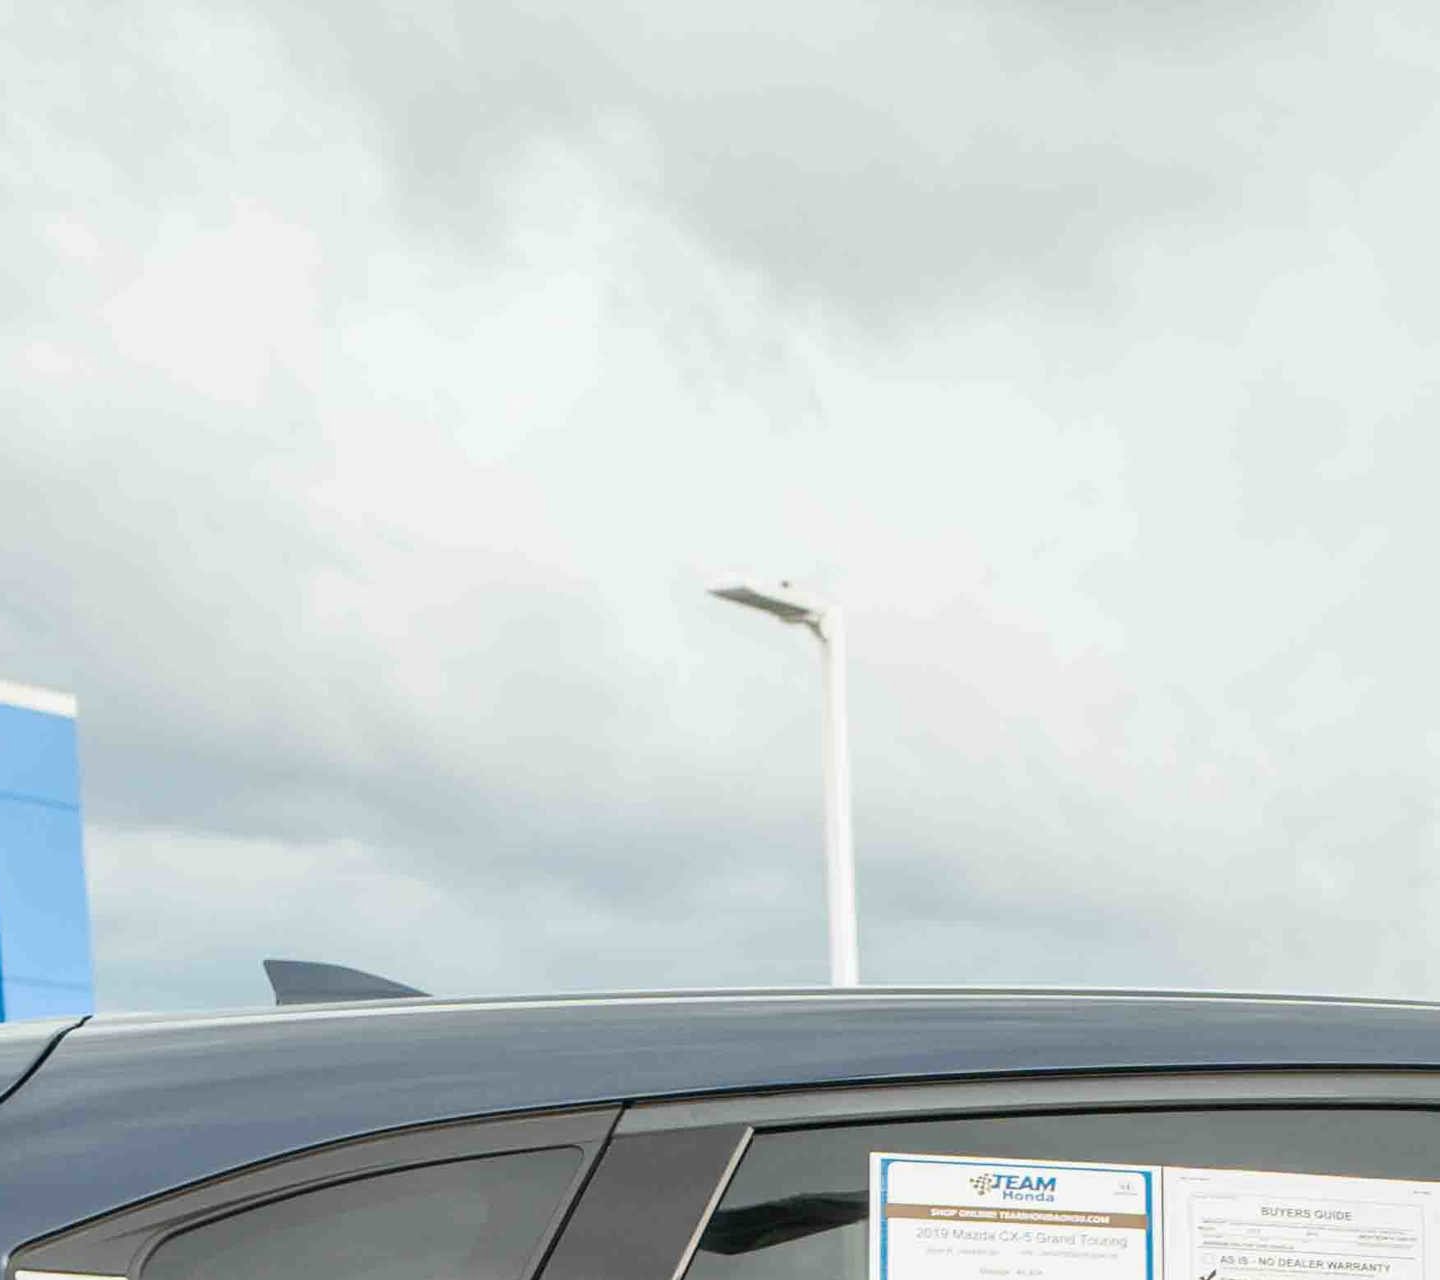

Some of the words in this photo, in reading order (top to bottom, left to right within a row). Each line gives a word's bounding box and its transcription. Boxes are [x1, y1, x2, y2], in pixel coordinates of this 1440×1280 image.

[991, 1173, 1057, 1192] TEAM
[1002, 1190, 1055, 1203] Honda
[1260, 1206, 1310, 1219] BUYERS
[1314, 1208, 1352, 1221] GUIDE
[1036, 1232, 1078, 1247] Grand
[1220, 1255, 1235, 1265] AS
[1238, 1256, 1249, 1266] IS
[1258, 1256, 1275, 1267] NO
[1278, 1257, 1324, 1269] DEALER
[1327, 1260, 1392, 1273] WARRANTY
